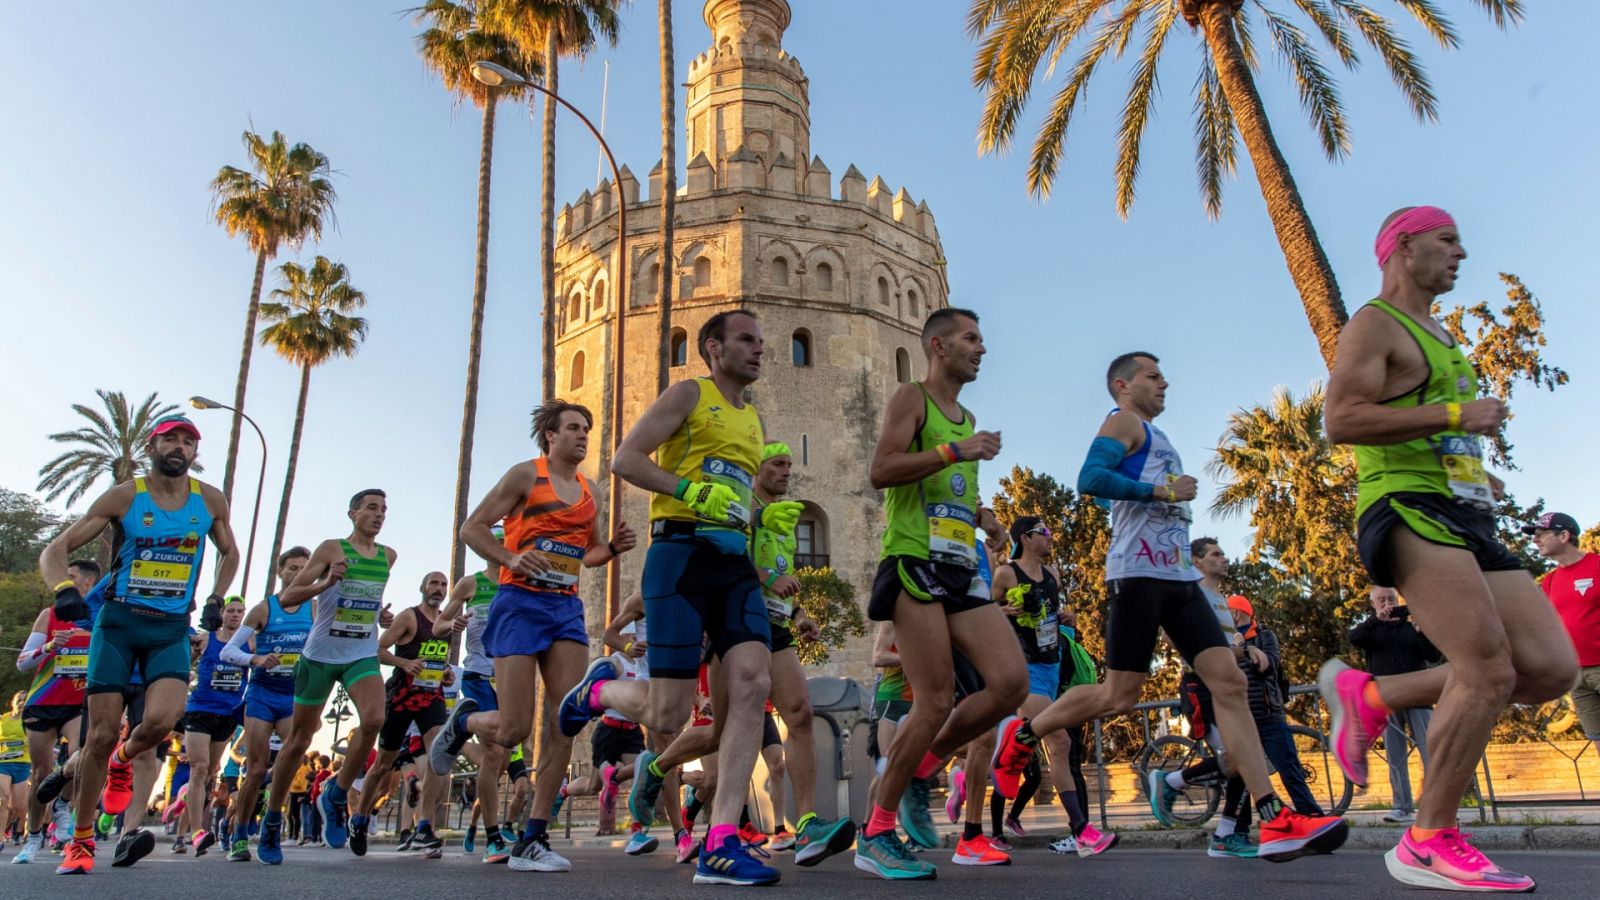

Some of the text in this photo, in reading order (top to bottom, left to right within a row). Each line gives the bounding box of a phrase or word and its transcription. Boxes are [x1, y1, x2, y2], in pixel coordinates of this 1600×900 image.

[553, 544, 579, 558] ZURICH
[154, 552, 188, 563] ZURICH
[153, 569, 171, 578] 517
[418, 641, 450, 656] 100
